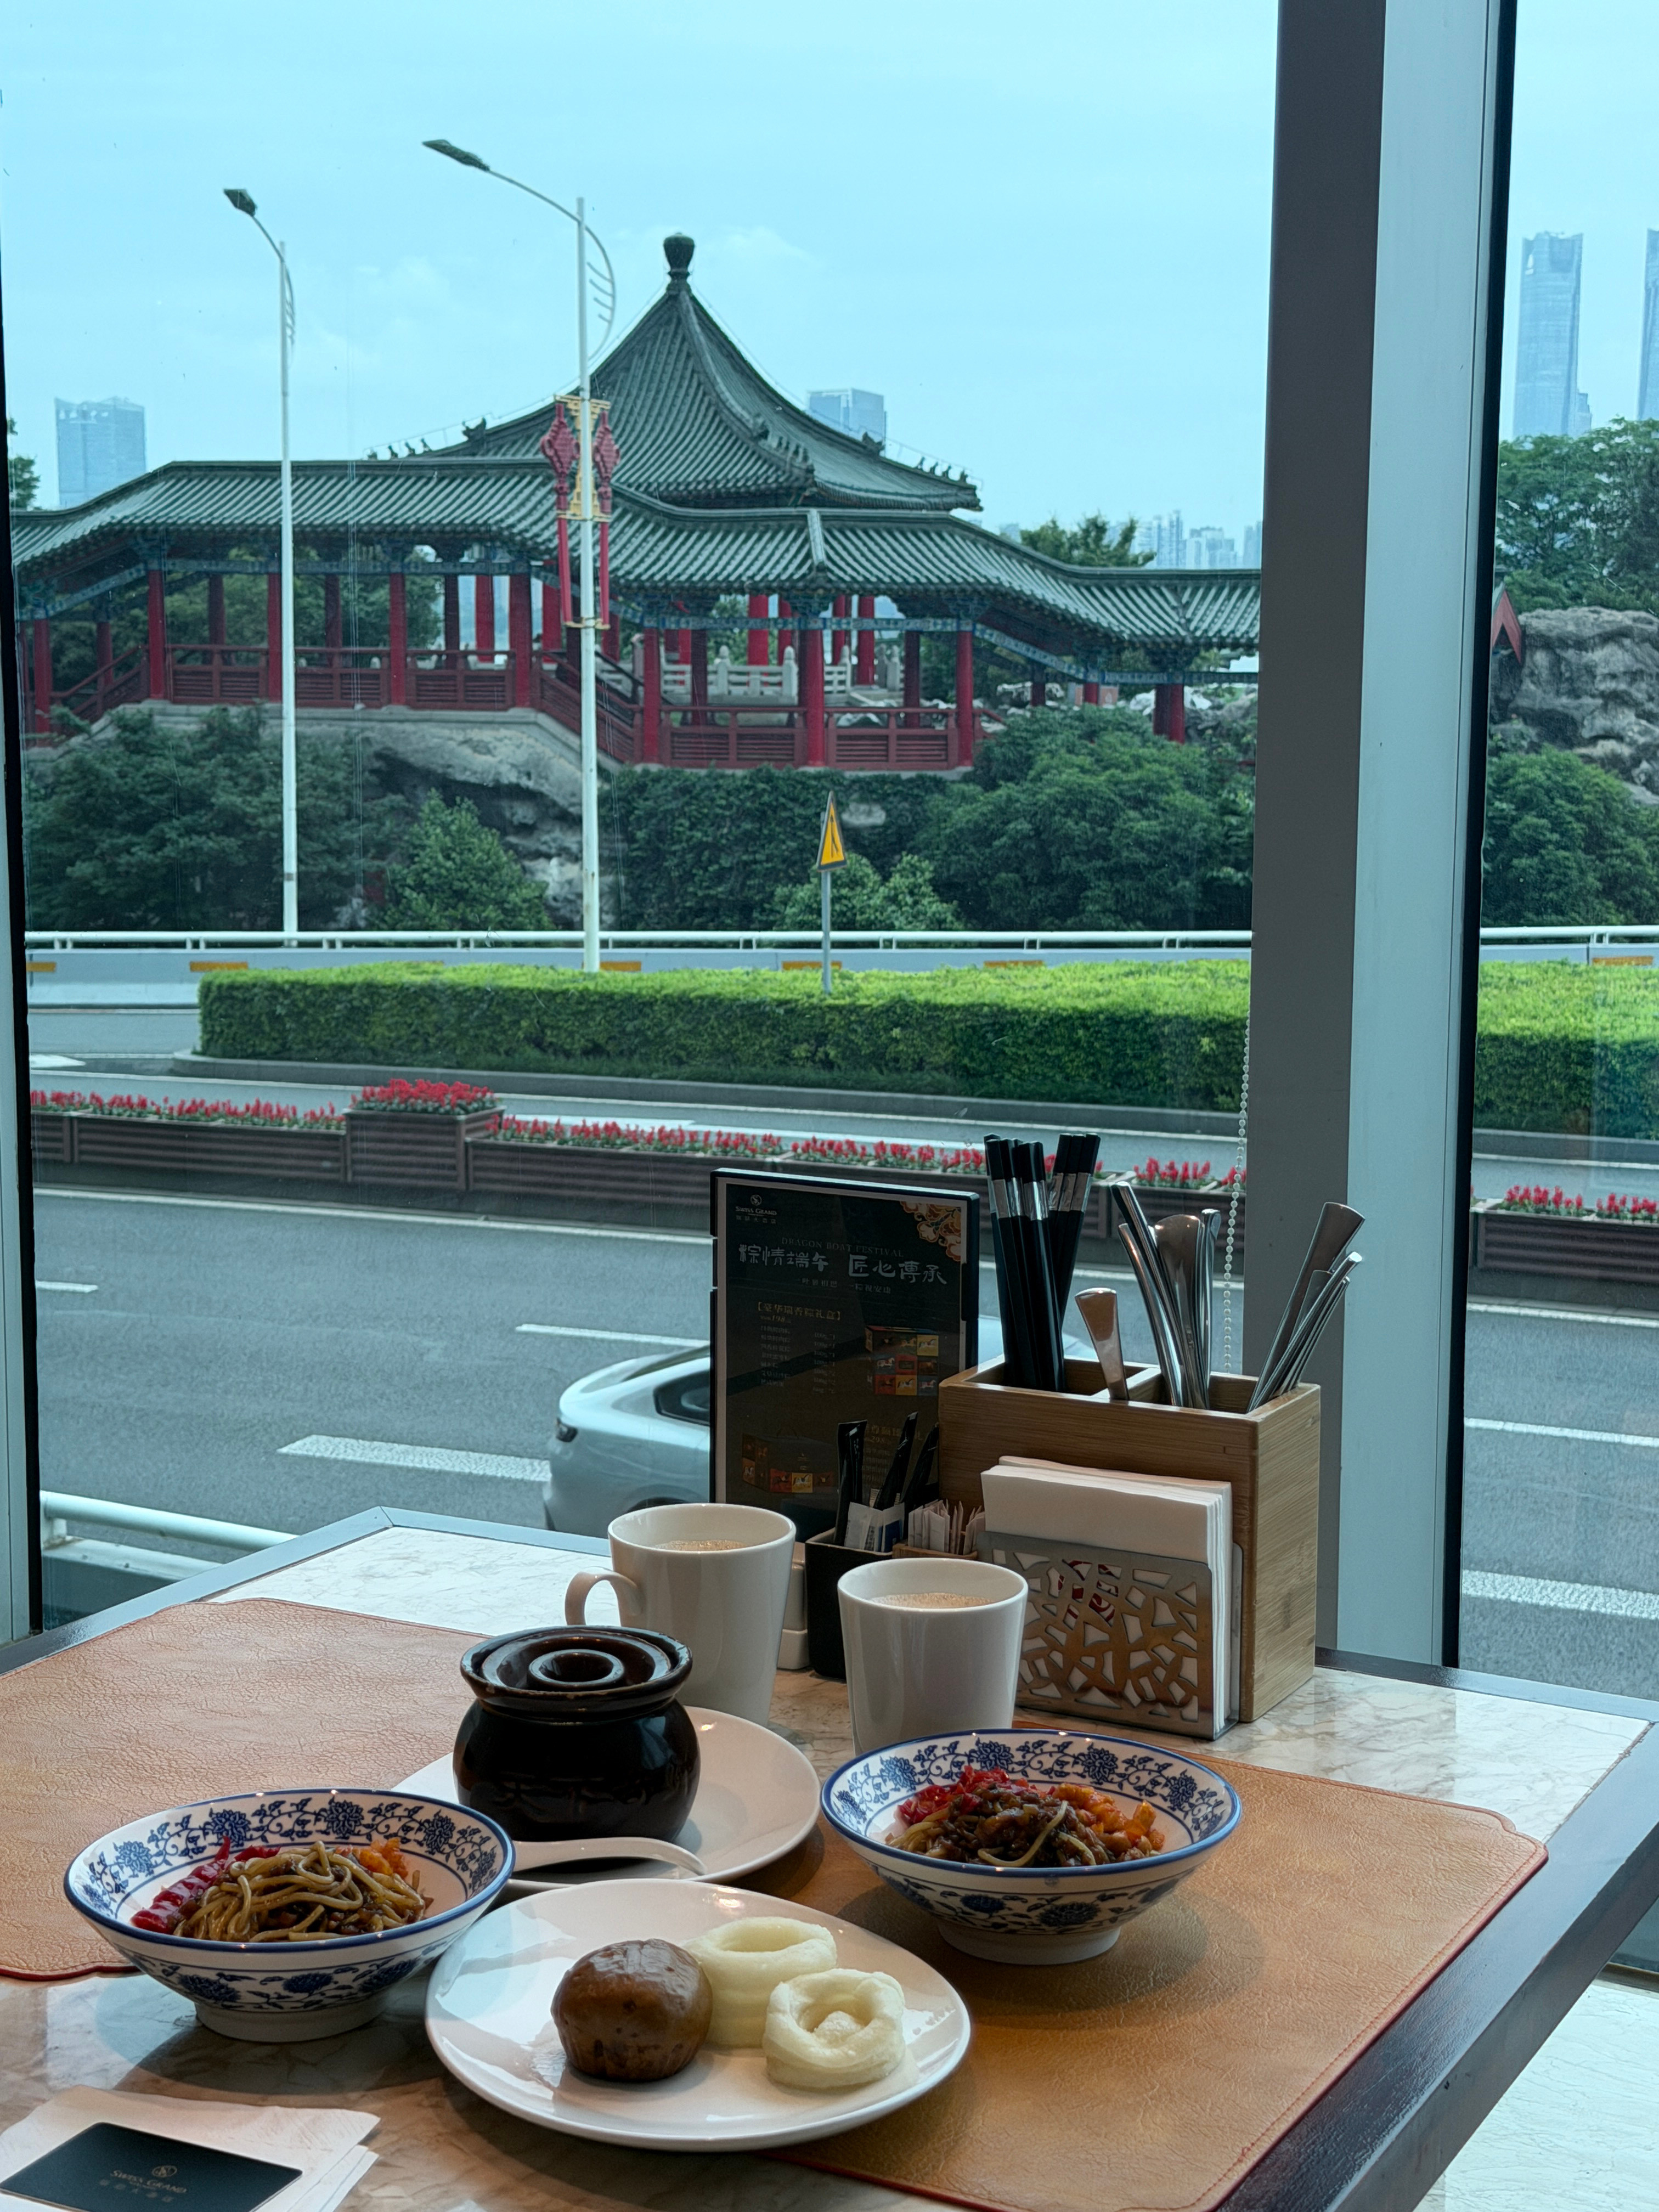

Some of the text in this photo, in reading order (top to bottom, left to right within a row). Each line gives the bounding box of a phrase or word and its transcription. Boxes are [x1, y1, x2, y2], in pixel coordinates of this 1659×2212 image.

[781, 1237, 904, 1257] DRAGON BOAT FESTIVAL
[738, 1244, 947, 1284] 粽情端午 匠心傳承
[110, 2170, 144, 2183] SWISS
[146, 2179, 187, 2193] GRAND
